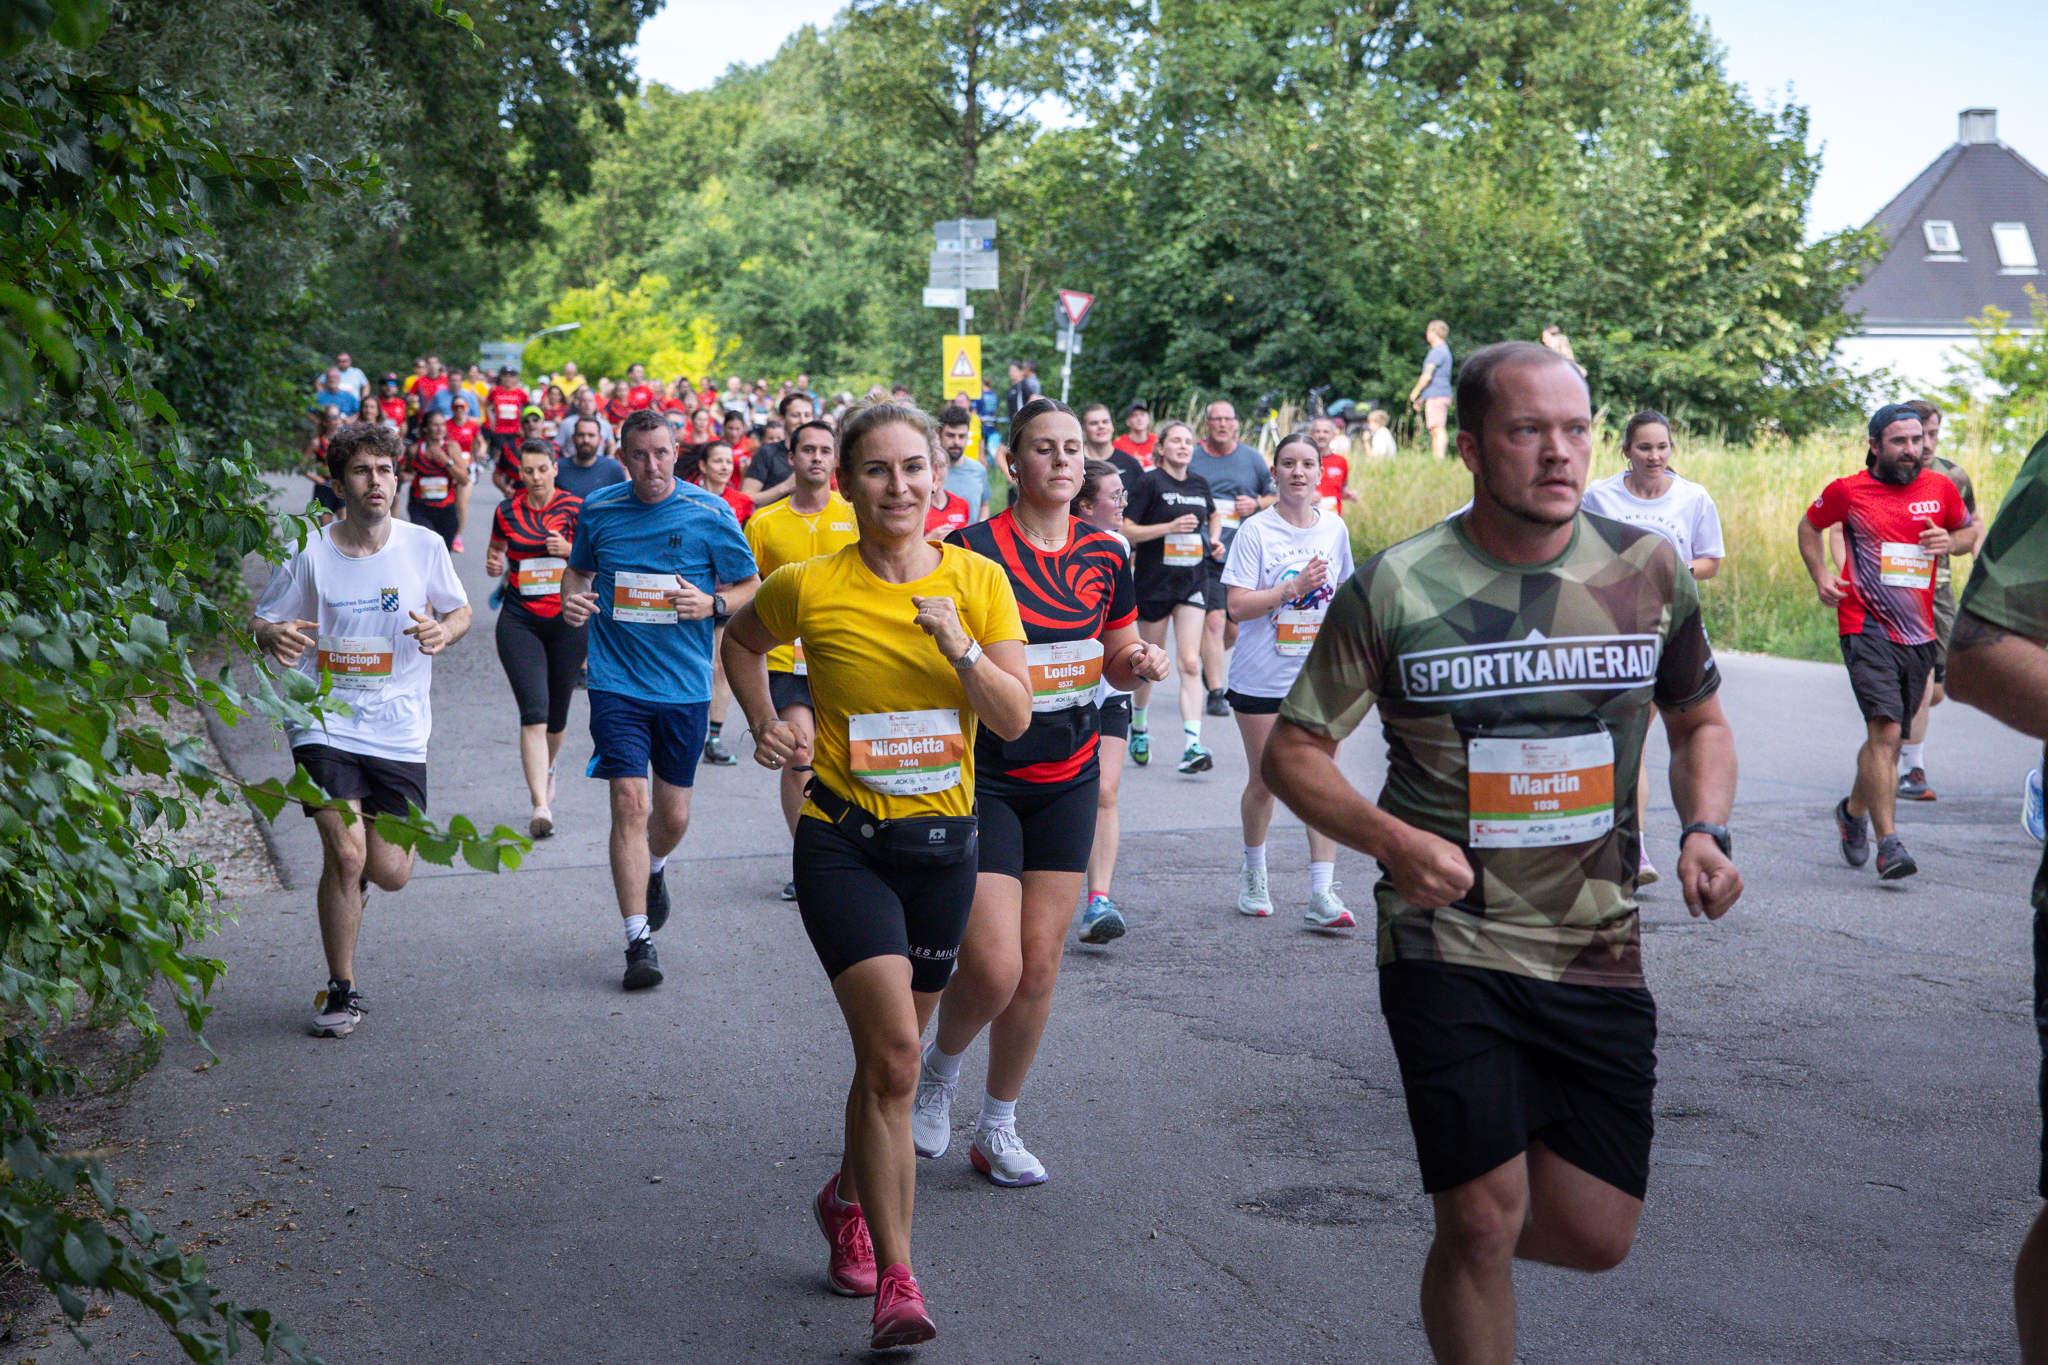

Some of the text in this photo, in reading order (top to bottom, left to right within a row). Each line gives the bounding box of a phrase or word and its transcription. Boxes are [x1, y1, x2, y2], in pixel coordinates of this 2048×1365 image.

[1890, 557, 1929, 569] Christoph
[628, 588, 664, 600] Manuel
[352, 605, 380, 614] Ingolstadt
[328, 652, 381, 666] Christoph
[1044, 663, 1086, 679] Louisa
[1410, 645, 1653, 693] SPORTKAMERAD
[871, 737, 944, 757] Nicoletta
[898, 758, 919, 768] 7444
[1510, 773, 1580, 796] Martin
[908, 944, 931, 957] LES
